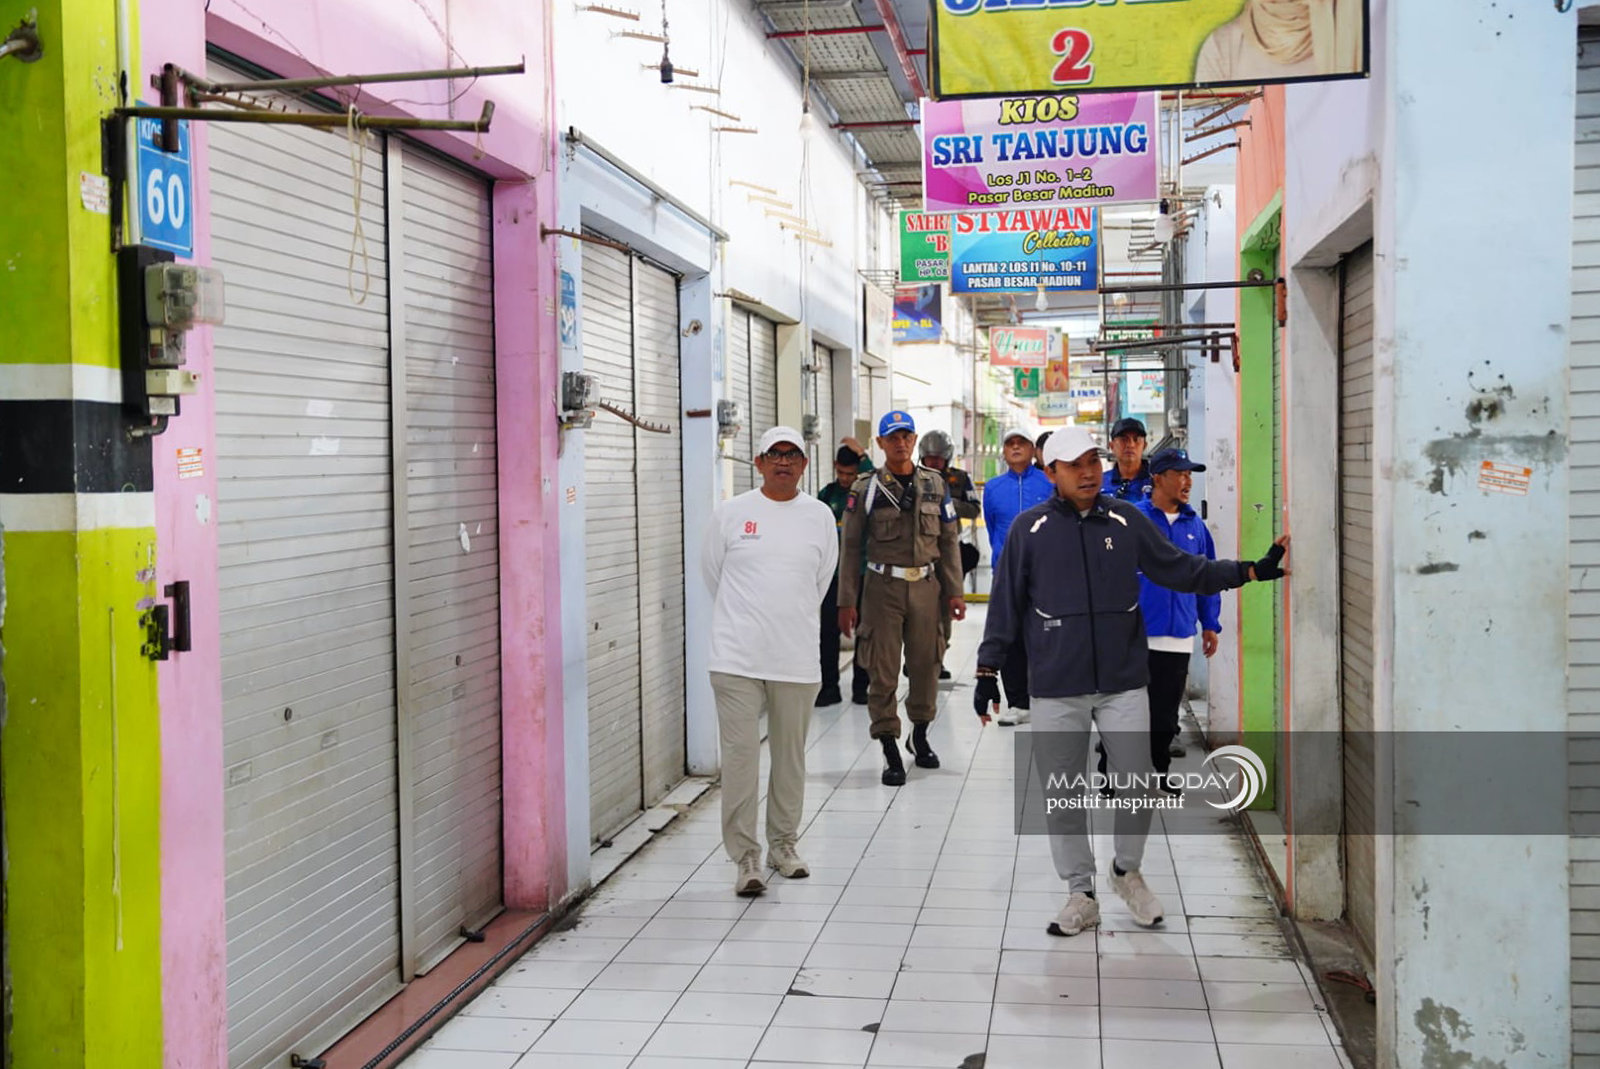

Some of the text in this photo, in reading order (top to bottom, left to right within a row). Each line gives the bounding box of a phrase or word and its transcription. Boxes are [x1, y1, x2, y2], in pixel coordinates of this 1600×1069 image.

[1051, 28, 1094, 84] 2
[999, 96, 1079, 125] KIOS
[932, 124, 1148, 167] SRI TANJUNG
[987, 174, 1013, 187] Los
[1035, 172, 1061, 184] No.
[1067, 168, 1093, 182] 1-2
[146, 168, 185, 229] 60
[968, 184, 1114, 204] Pasar Besar Madiun
[1023, 231, 1092, 254] Collection
[963, 262, 999, 274] LANTAI
[1000, 262, 1007, 273] 2
[1009, 262, 1028, 273] LOS
[1041, 262, 1058, 272] No.
[1060, 261, 1087, 272] 10-11
[967, 275, 1082, 288] PASAR BESAR MADIUN
[744, 521, 757, 534] 81
